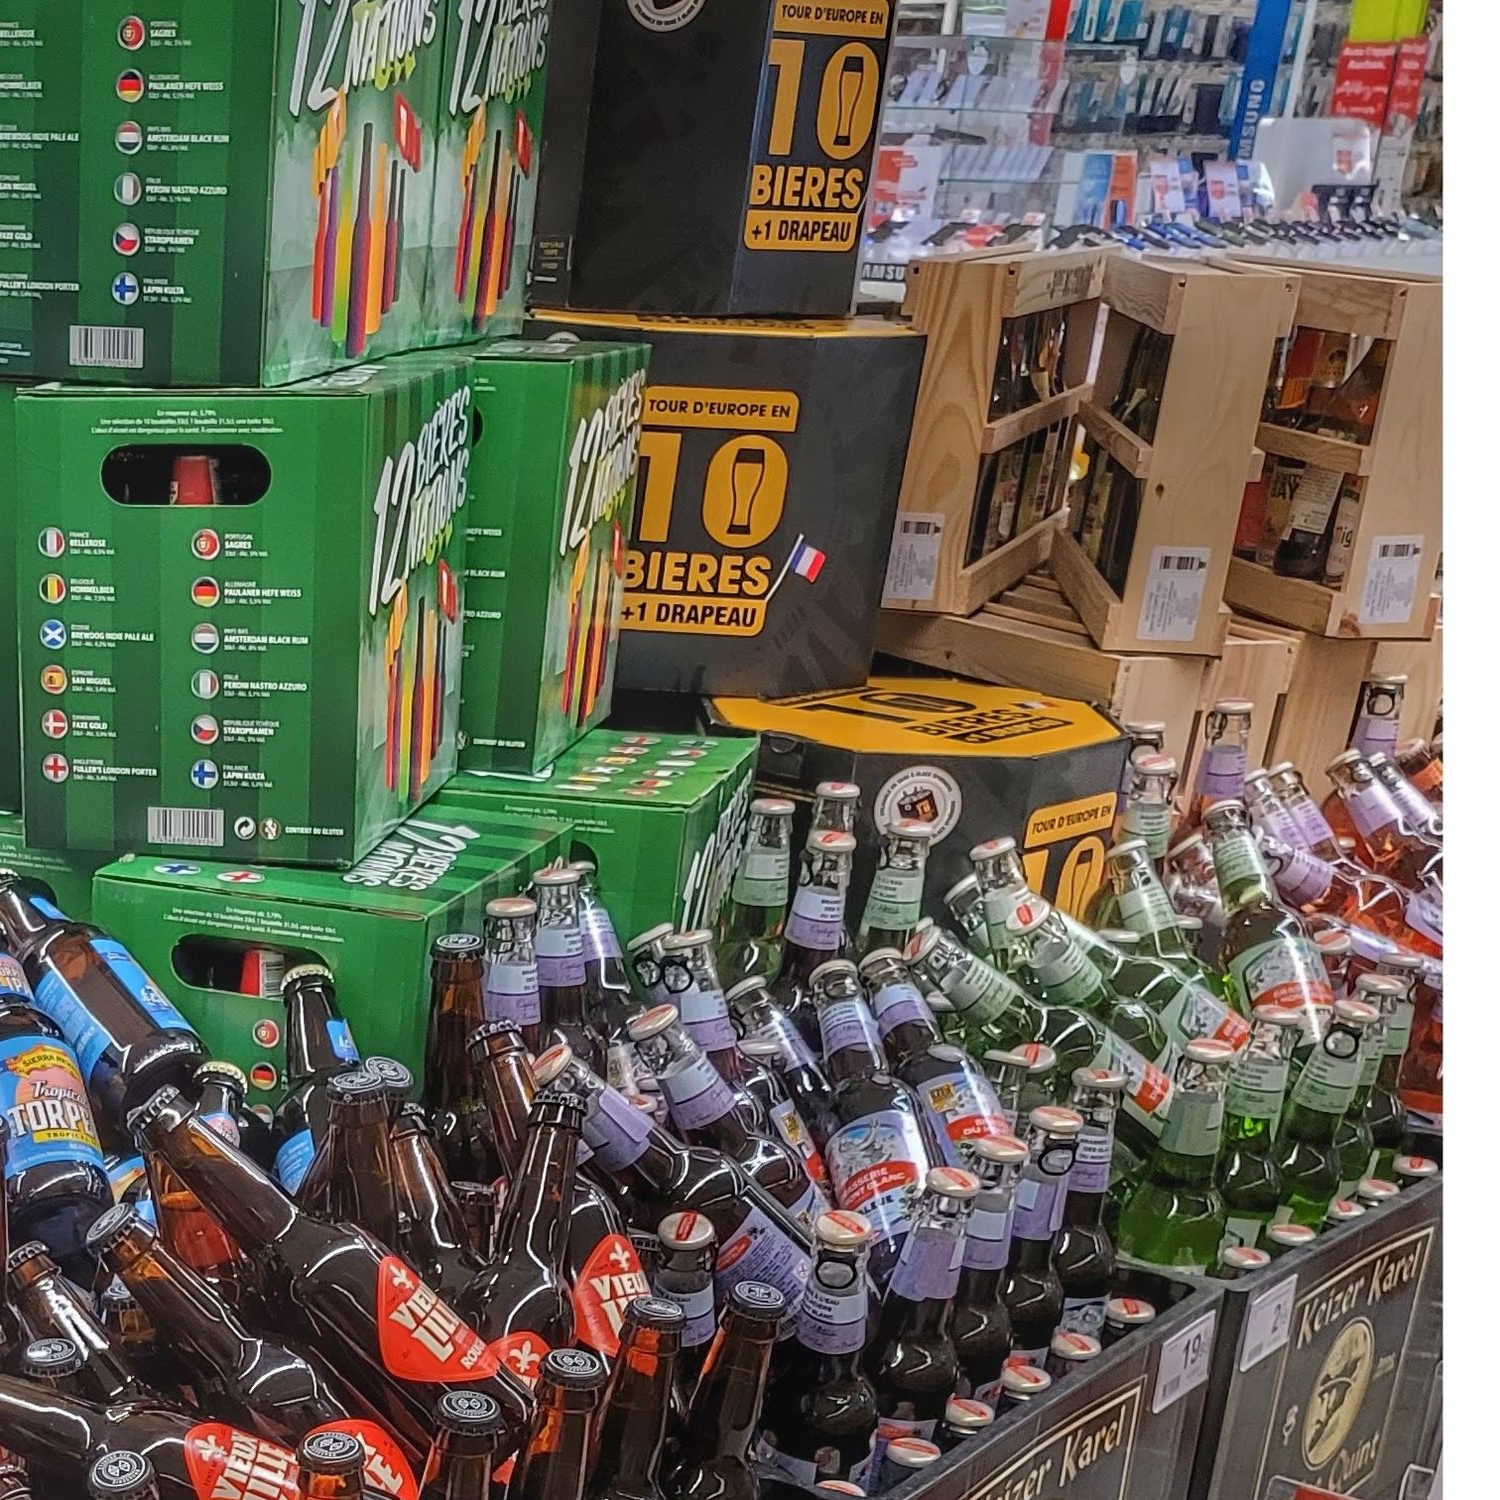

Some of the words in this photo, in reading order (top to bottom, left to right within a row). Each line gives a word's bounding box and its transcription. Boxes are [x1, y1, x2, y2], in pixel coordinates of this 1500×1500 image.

[782, 5, 811, 19] TOUR
[814, 7, 867, 23] D'EUROPE
[870, 11, 883, 25] EN
[767, 38, 880, 160] 10
[750, 167, 864, 209] BIERES
[778, 219, 851, 242] DRAPEAU
[649, 399, 688, 413] TOUR
[693, 401, 767, 417] D'EUROPE
[772, 405, 791, 418] EN
[624, 551, 772, 596] BIERES
[224, 589, 261, 597] PAULANER
[656, 603, 756, 627] DRAPEAU
[141, 633, 155, 642] ALE
[224, 635, 268, 644] AMSTERDAM
[268, 636, 291, 644] BLACK
[72, 676, 86, 684] SAN
[89, 722, 108, 730] GOLD
[223, 726, 275, 736] STAROPRAMEN
[102, 766, 131, 775] LONDON
[131, 768, 158, 777] PORTER
[223, 772, 244, 780] LAPIN
[1032, 818, 1056, 834] TOUR
